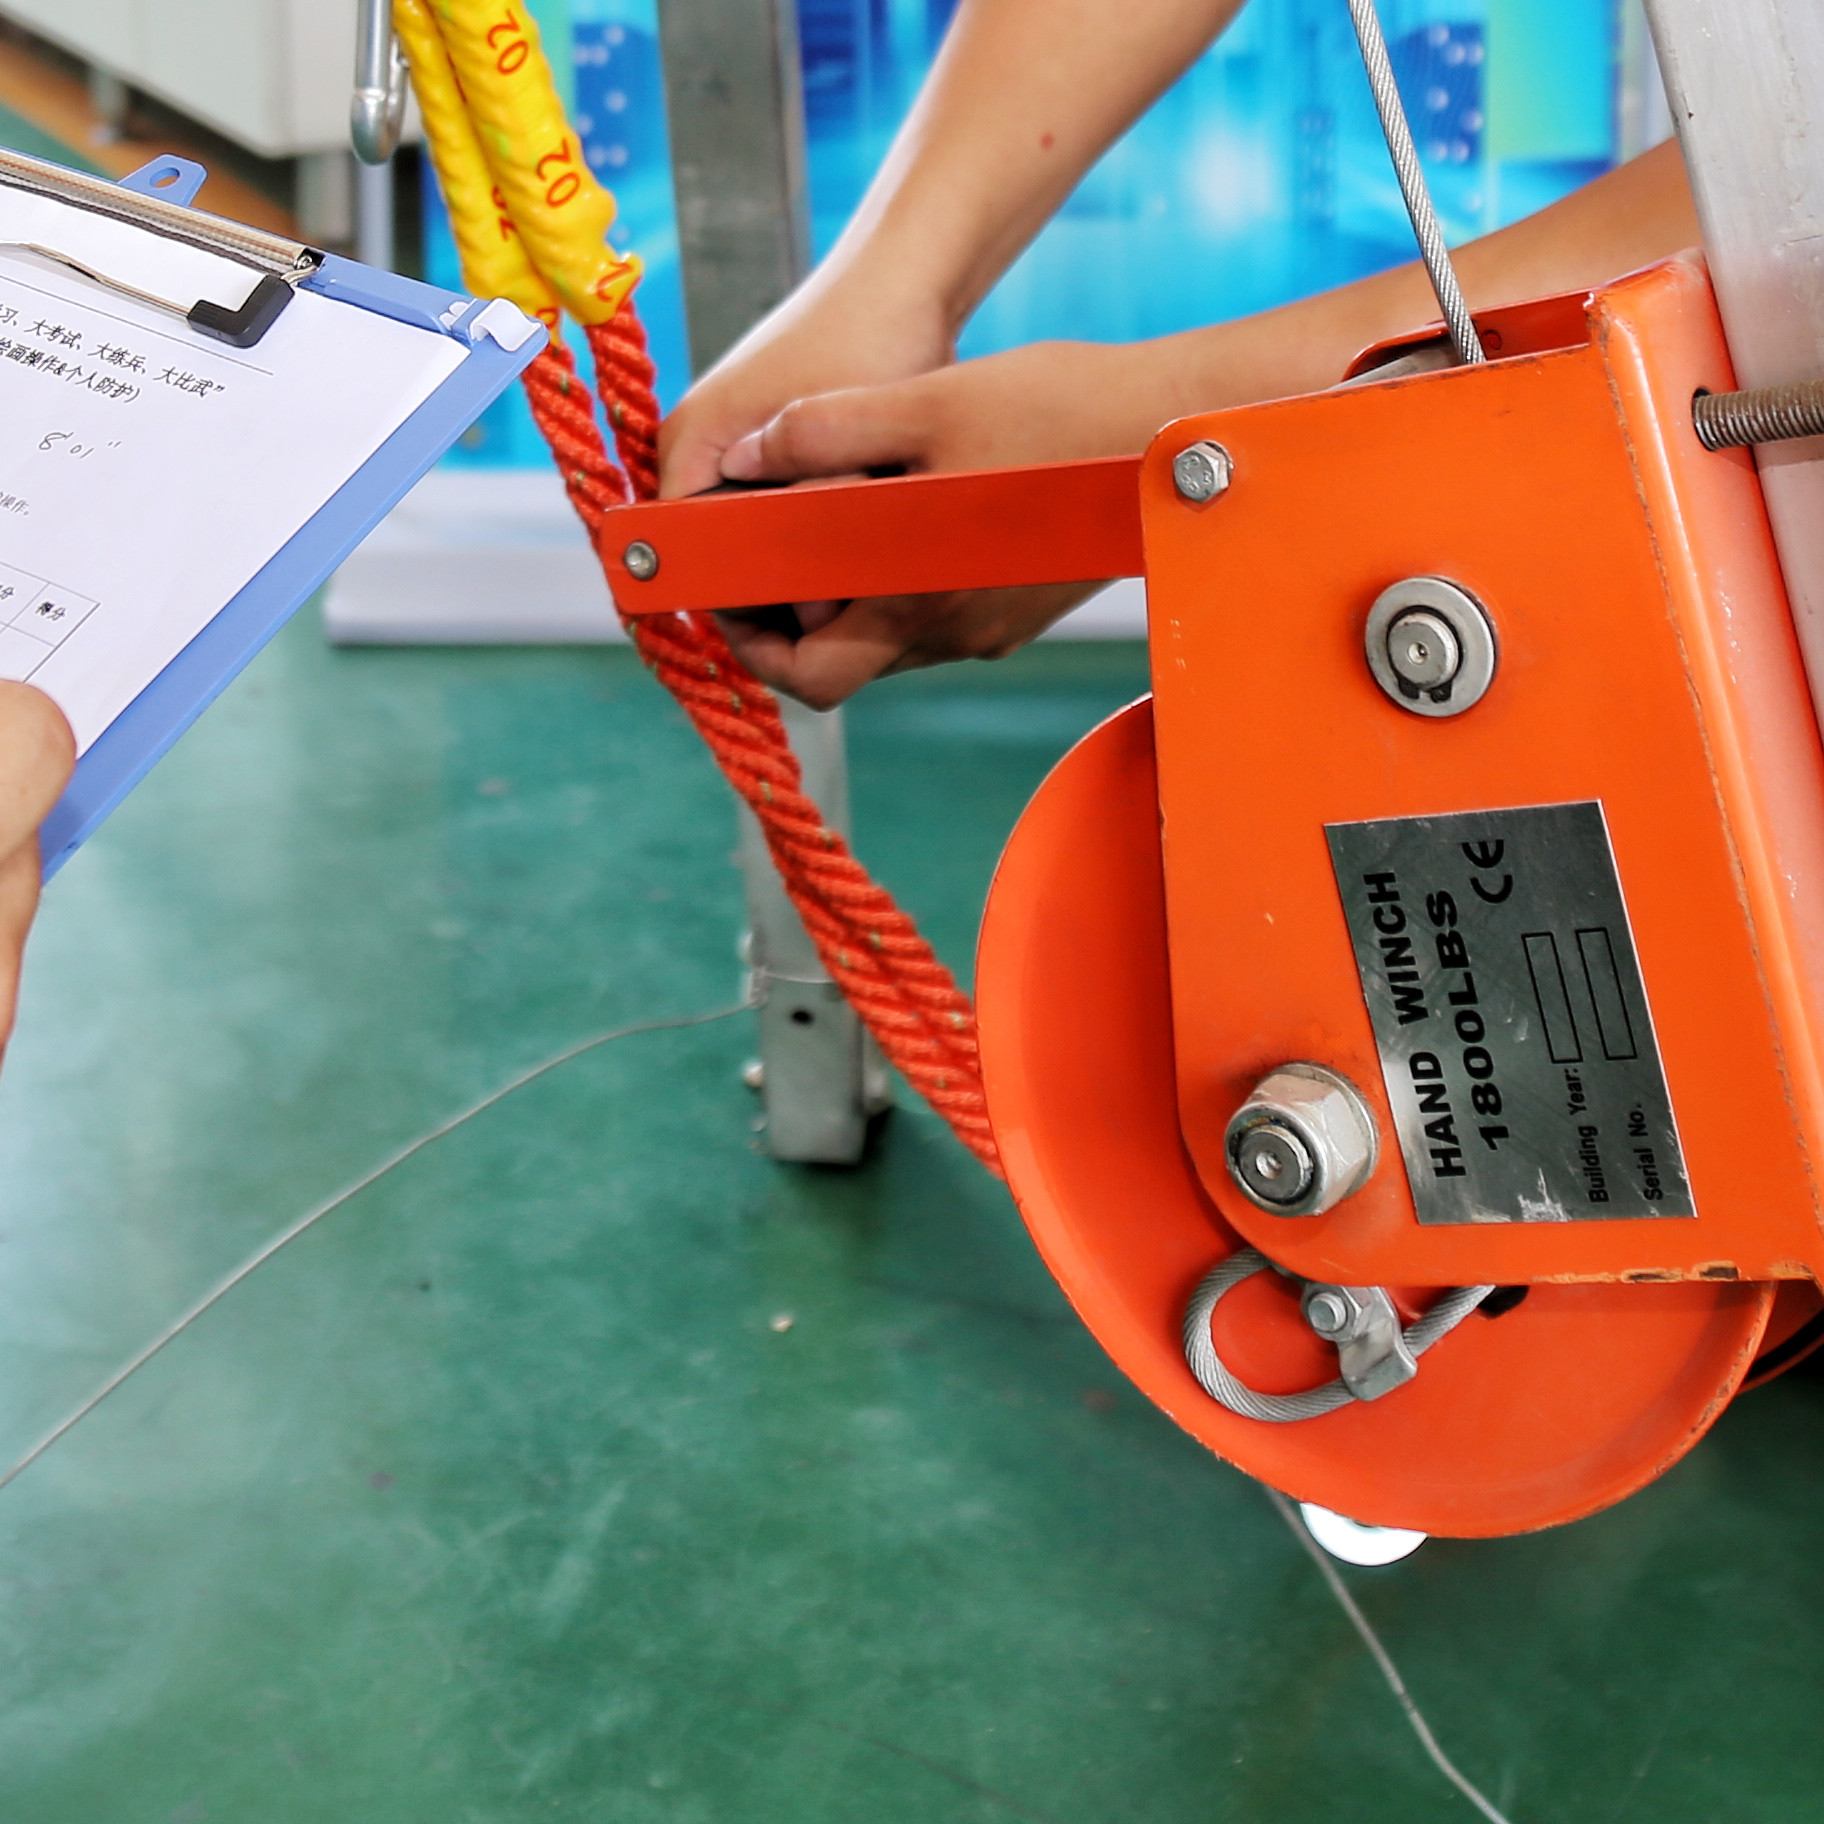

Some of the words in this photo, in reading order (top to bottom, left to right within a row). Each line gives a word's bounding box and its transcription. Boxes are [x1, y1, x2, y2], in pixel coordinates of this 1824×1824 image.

[30, 599, 72, 624] 得分
[1362, 871, 1430, 1026] WINCH
[1425, 890, 1511, 1151] 1800LBS
[1408, 1051, 1467, 1178] HAND
[1563, 1066, 1588, 1116] Year:
[1626, 1103, 1649, 1139] No.
[1578, 1125, 1610, 1203] Building
[1642, 1147, 1665, 1201] Serial
